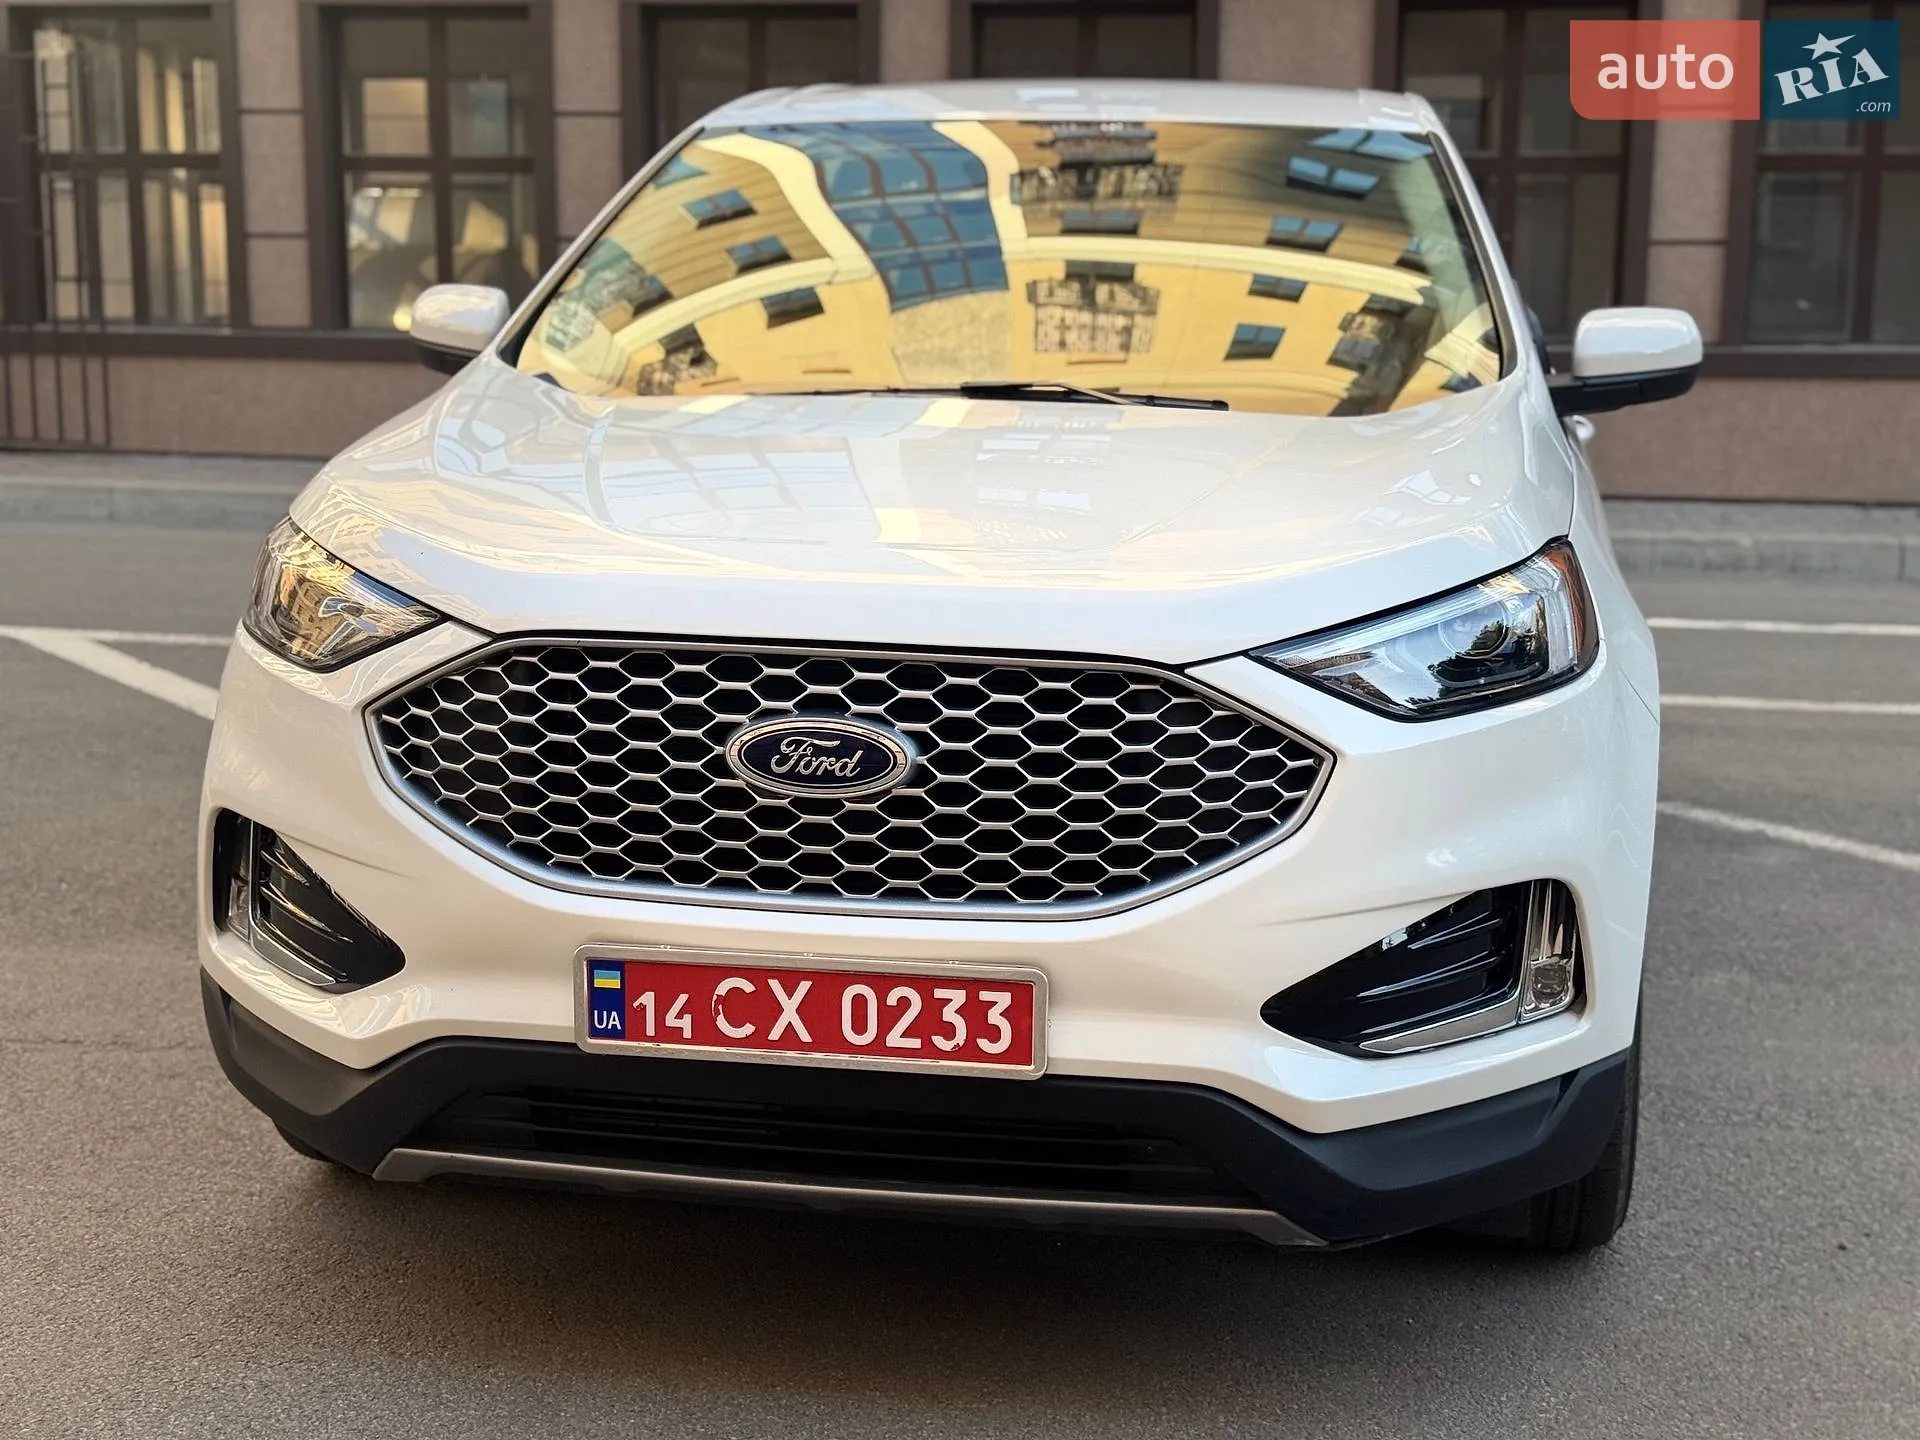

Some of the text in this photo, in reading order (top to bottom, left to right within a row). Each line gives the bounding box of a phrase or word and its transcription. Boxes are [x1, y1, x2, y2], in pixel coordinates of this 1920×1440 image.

[770, 736, 864, 777] Ford
[593, 1010, 622, 1031] UA
[632, 976, 1013, 1055] 14 CX 0233
